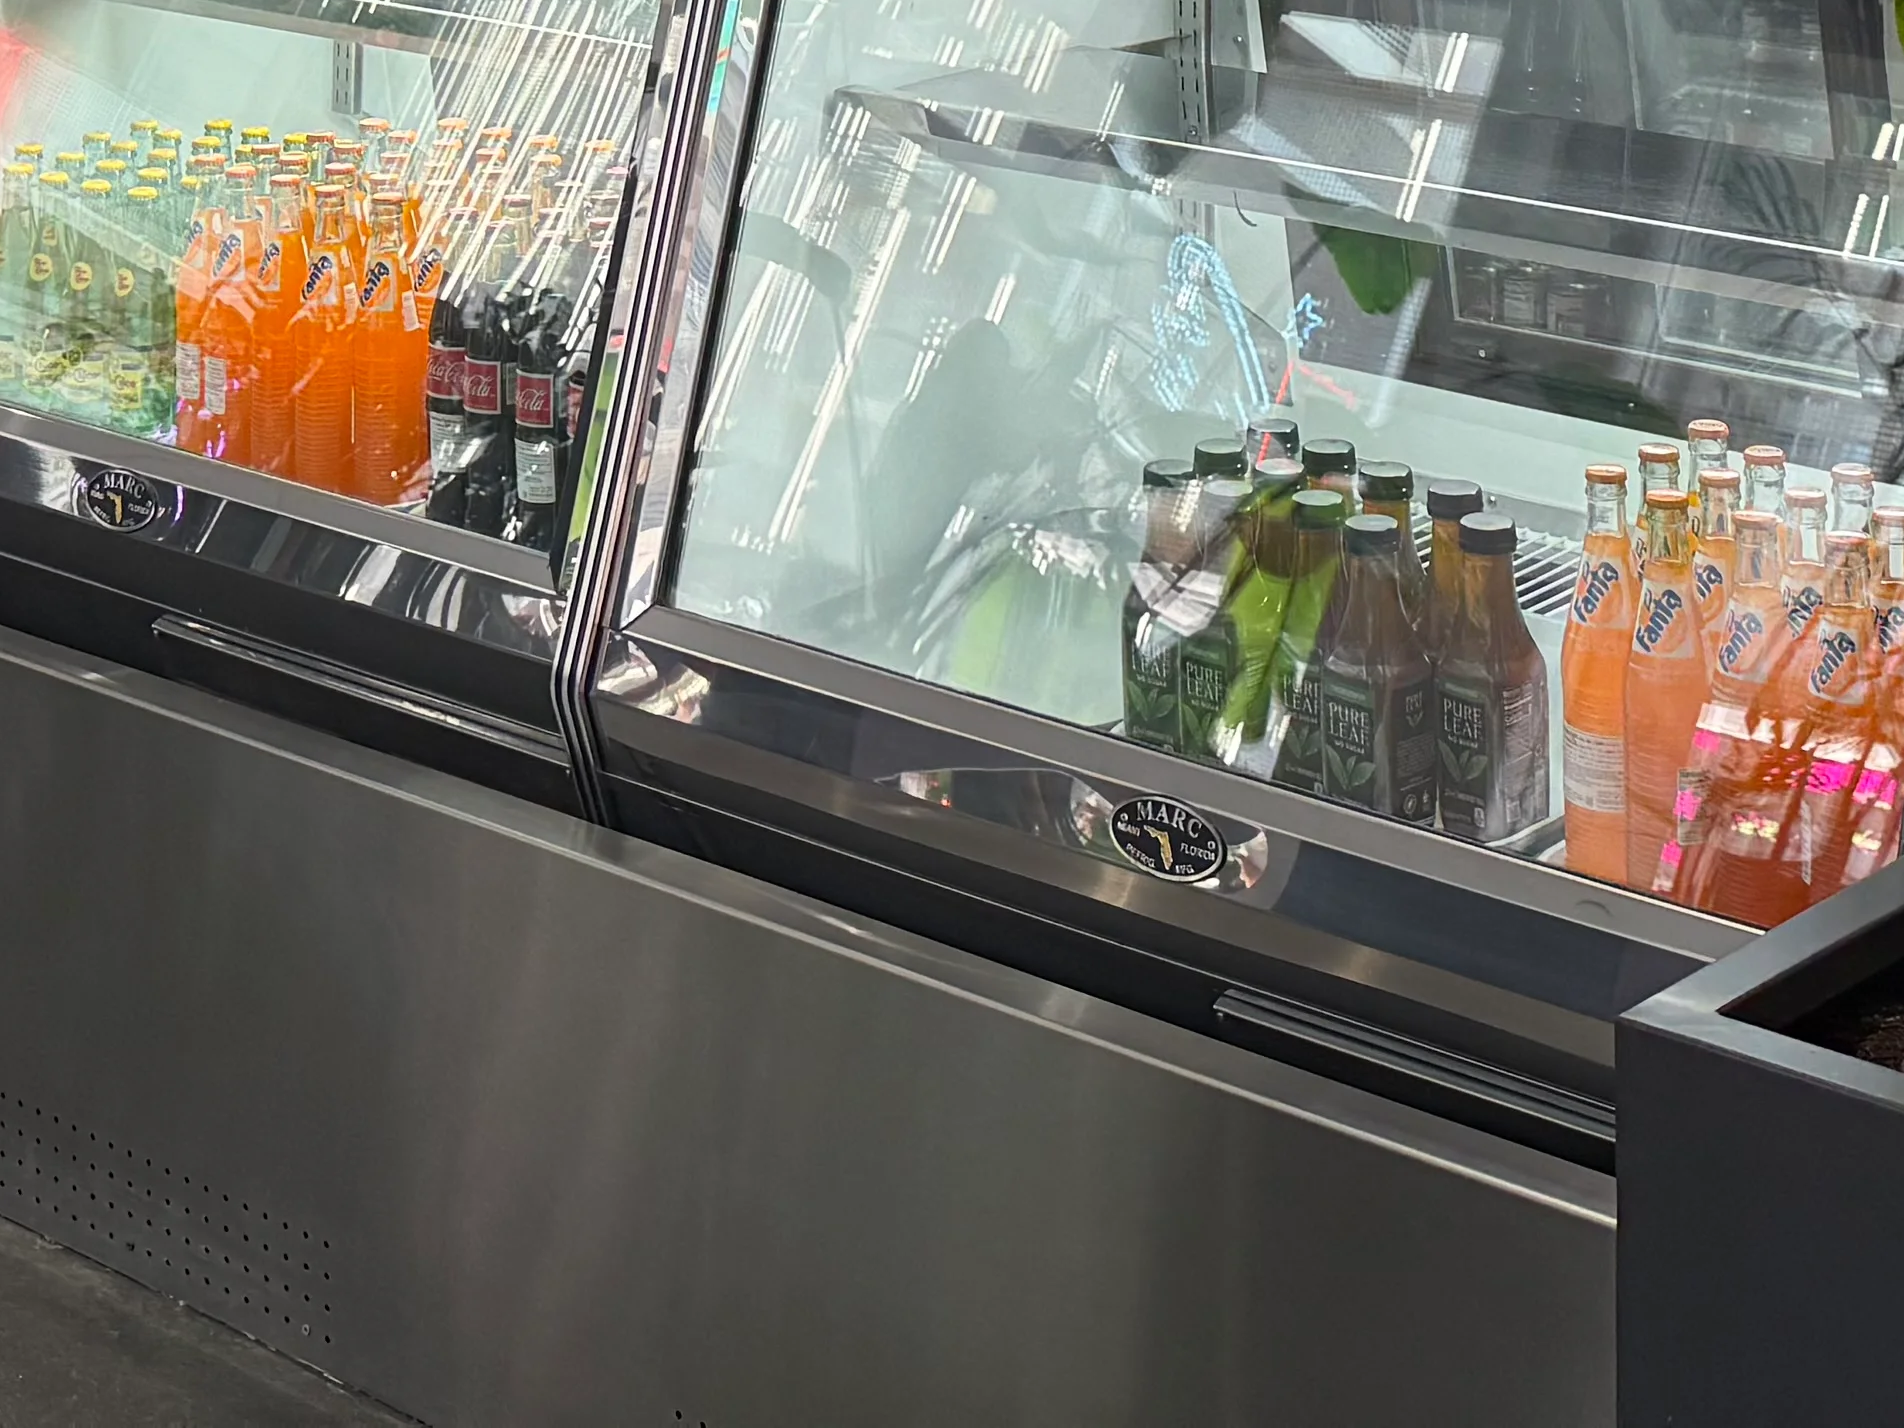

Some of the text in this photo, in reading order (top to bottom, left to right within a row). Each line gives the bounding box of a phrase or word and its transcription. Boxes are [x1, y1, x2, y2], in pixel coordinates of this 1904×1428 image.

[104, 473, 145, 499] MARC
[1573, 561, 1619, 624] Fanta
[1635, 588, 1684, 653] Fanta
[1719, 613, 1763, 673] Fanta
[1185, 660, 1223, 684] PURE
[1810, 631, 1857, 694] Fanta
[1186, 678, 1224, 703] LEAF
[1328, 701, 1370, 725] PURE
[1443, 697, 1482, 722] PURE
[1328, 721, 1370, 747] LEAF
[1443, 714, 1483, 740] LEAF
[1137, 801, 1204, 839] MARC
